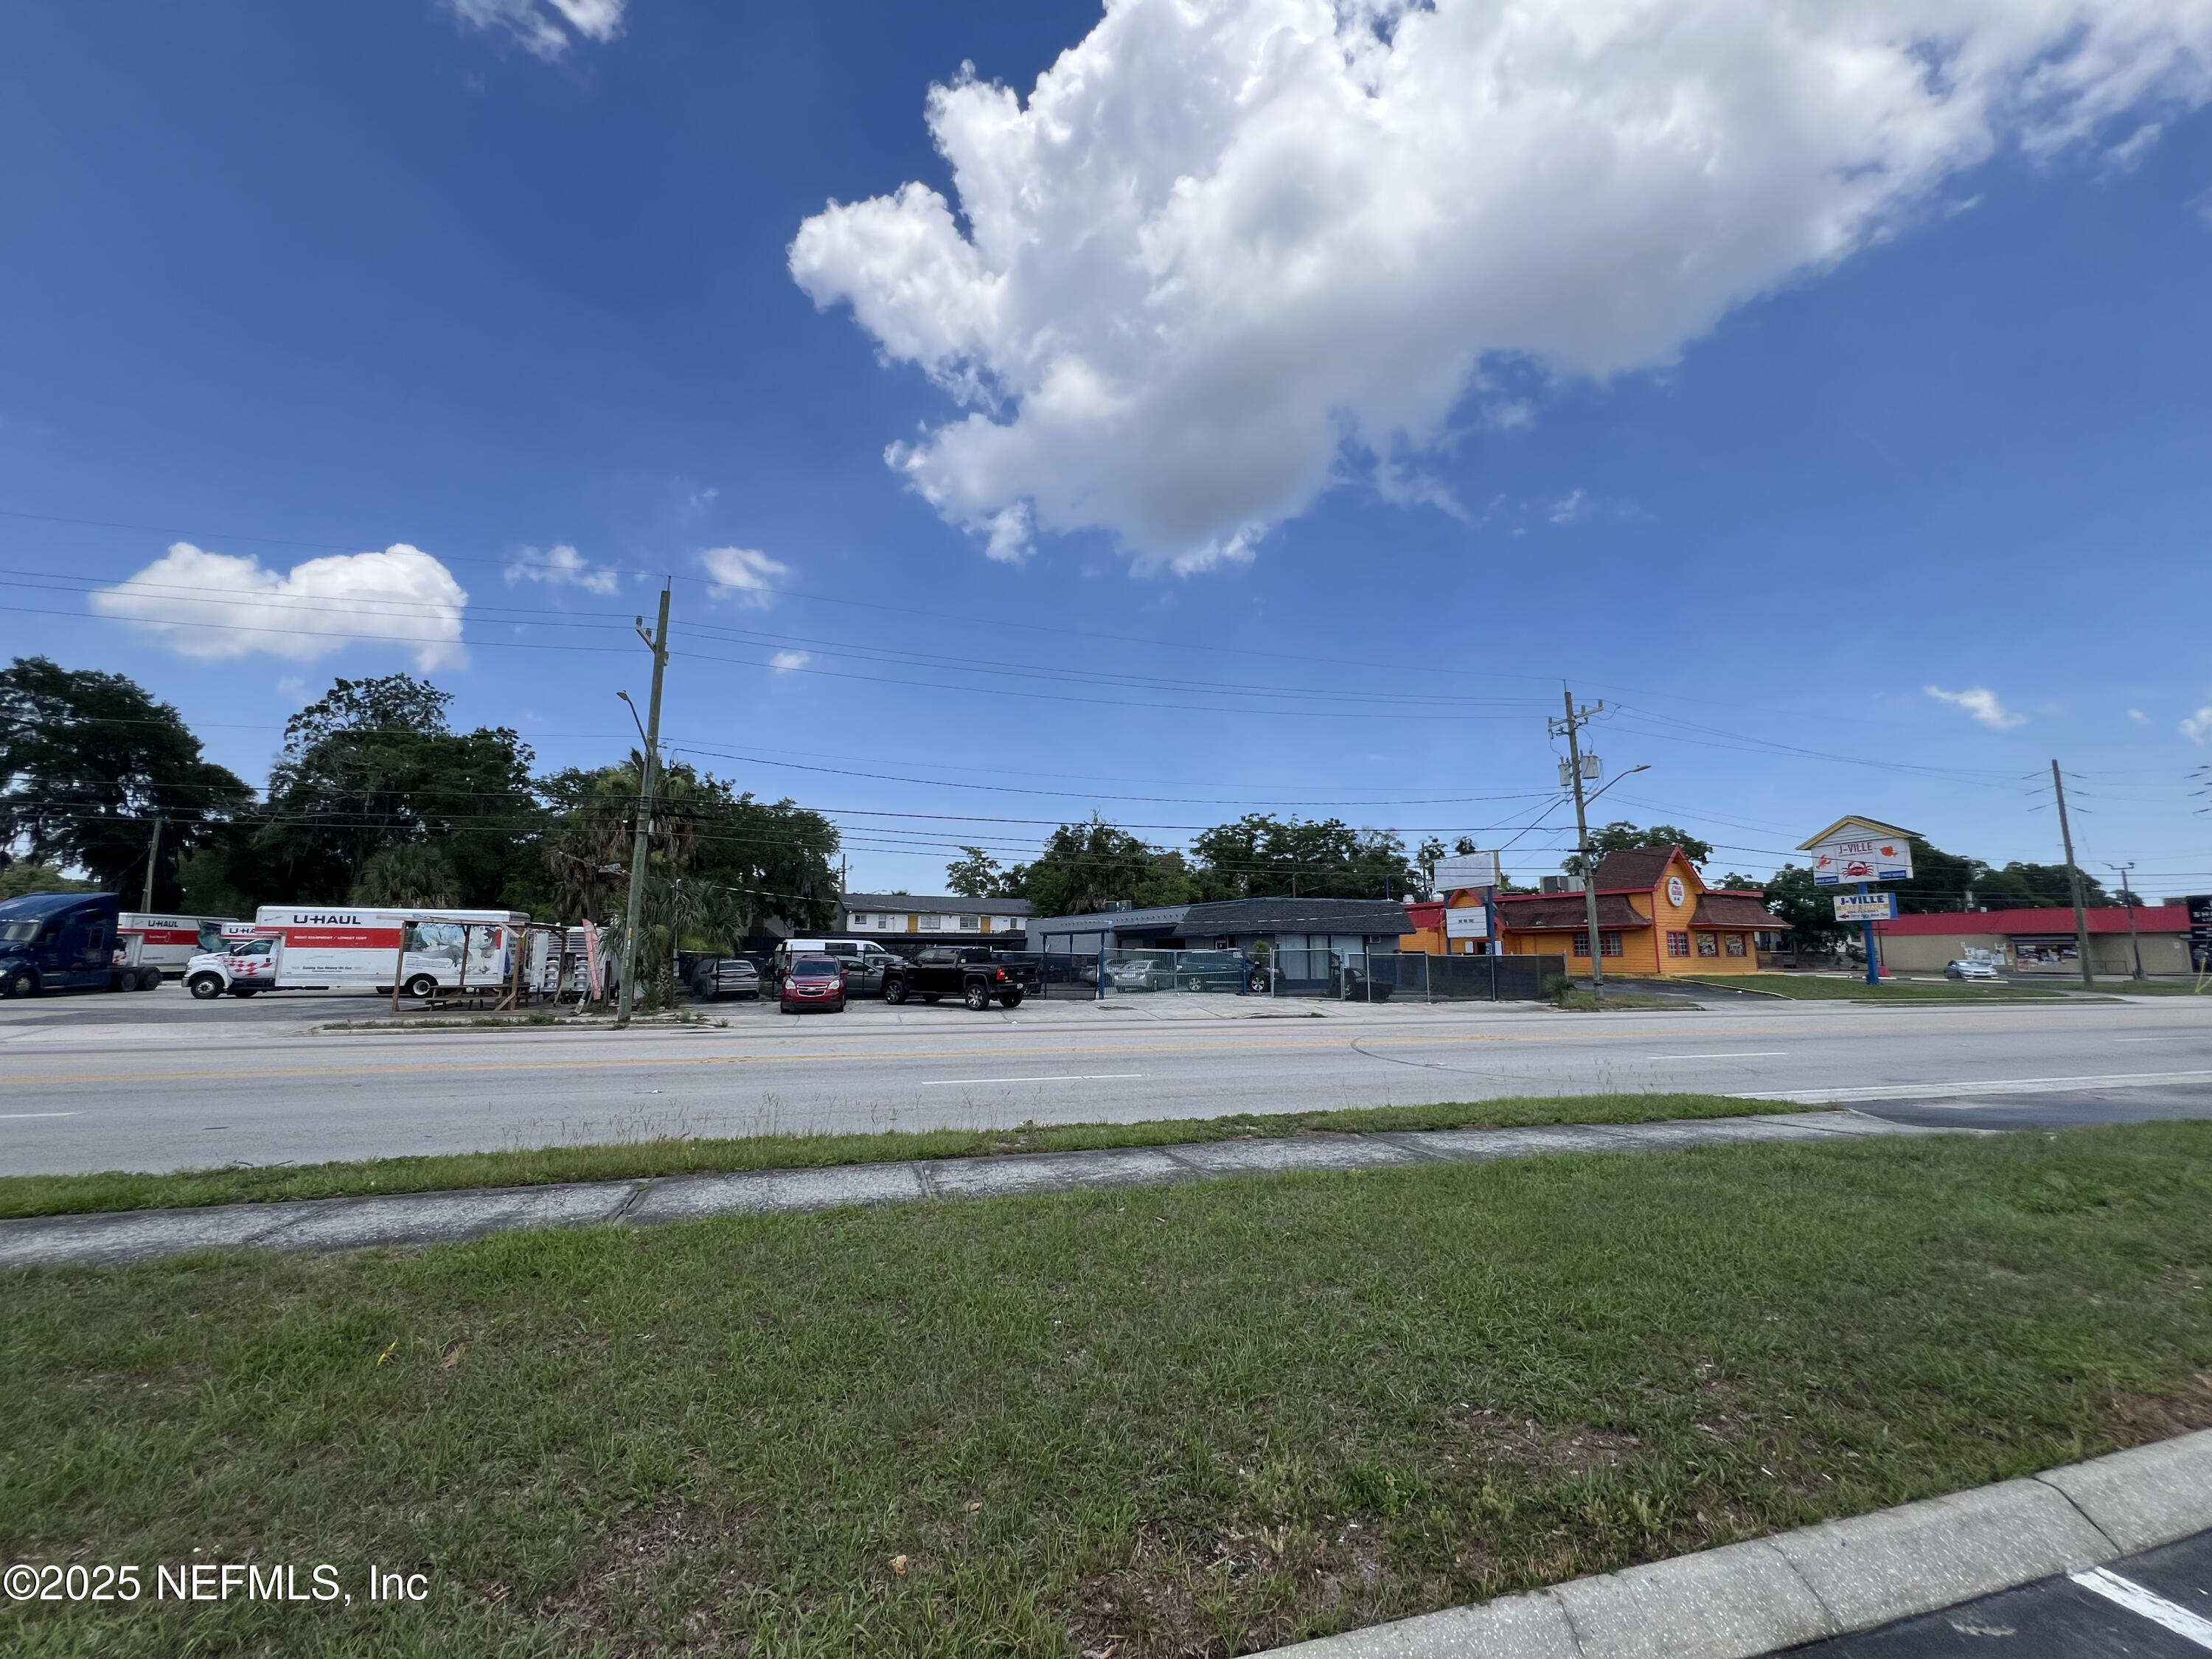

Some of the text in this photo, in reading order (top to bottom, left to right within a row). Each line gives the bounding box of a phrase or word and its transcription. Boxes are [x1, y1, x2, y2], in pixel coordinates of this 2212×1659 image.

[1838, 842, 1874, 854] J-VILLE
[1840, 895, 1885, 905] J-VILLE
[147, 919, 178, 928] U-HAUL
[293, 915, 361, 925] U-HAUL
